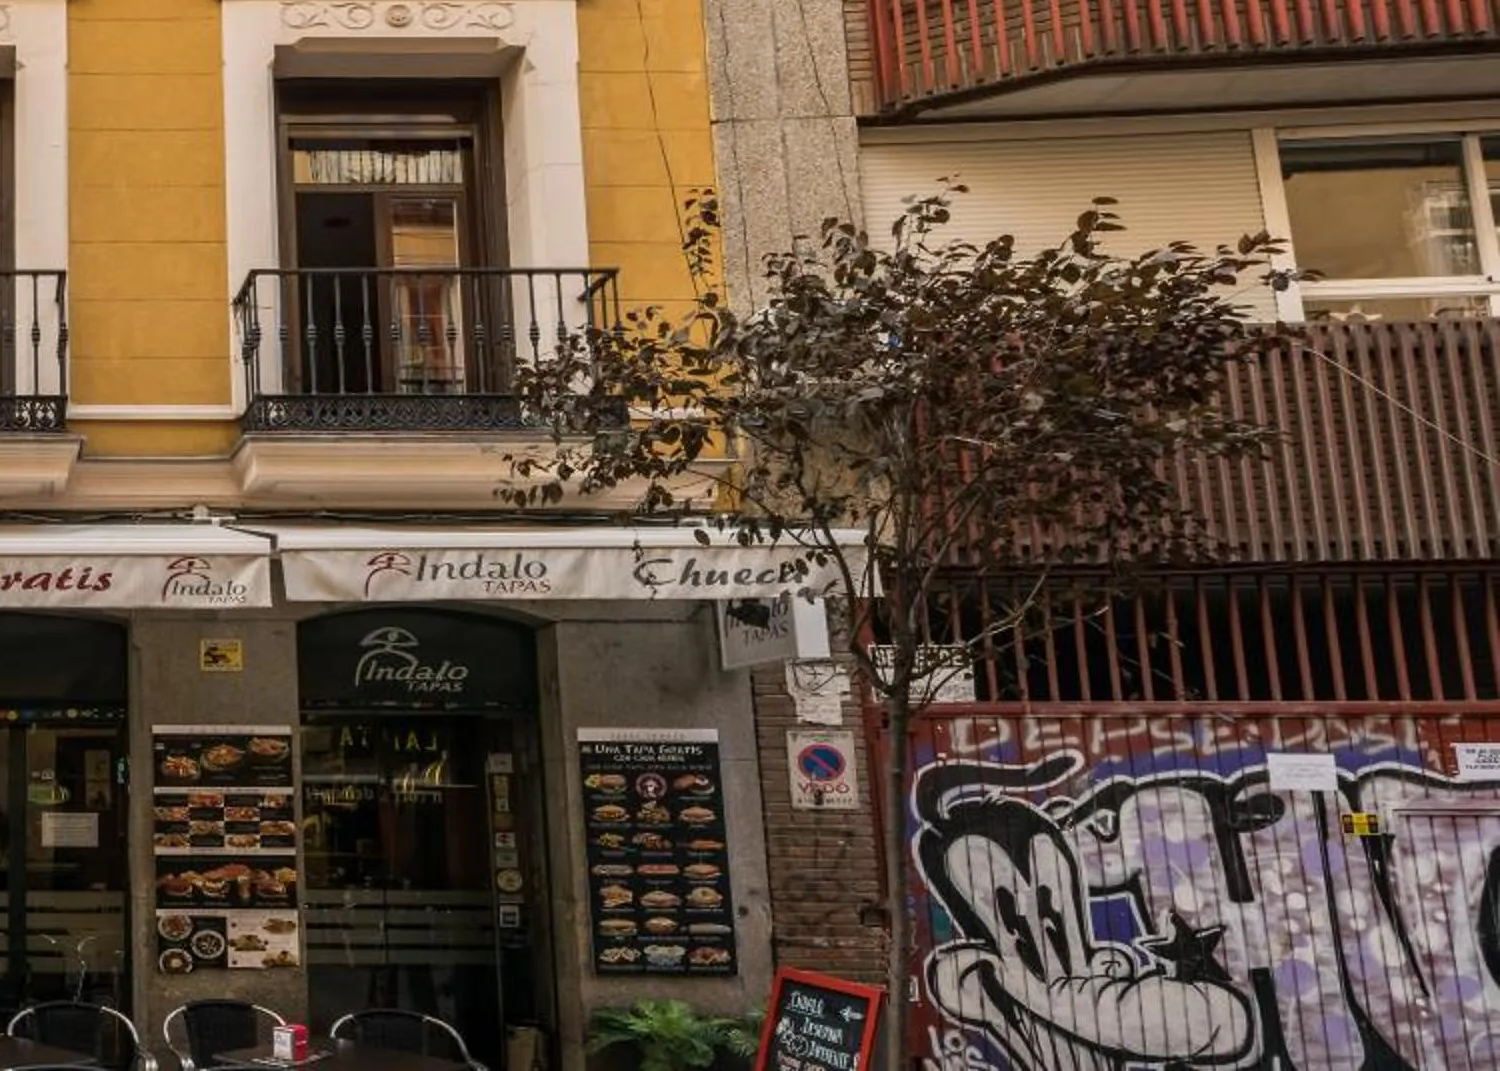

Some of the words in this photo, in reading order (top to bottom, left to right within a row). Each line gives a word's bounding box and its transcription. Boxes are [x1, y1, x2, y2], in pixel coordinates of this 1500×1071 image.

[414, 552, 548, 581] Indalo
[171, 580, 247, 598] Indalo
[482, 579, 552, 594] TAPAS
[363, 661, 469, 682] Indalo
[406, 681, 463, 693] TAPAS
